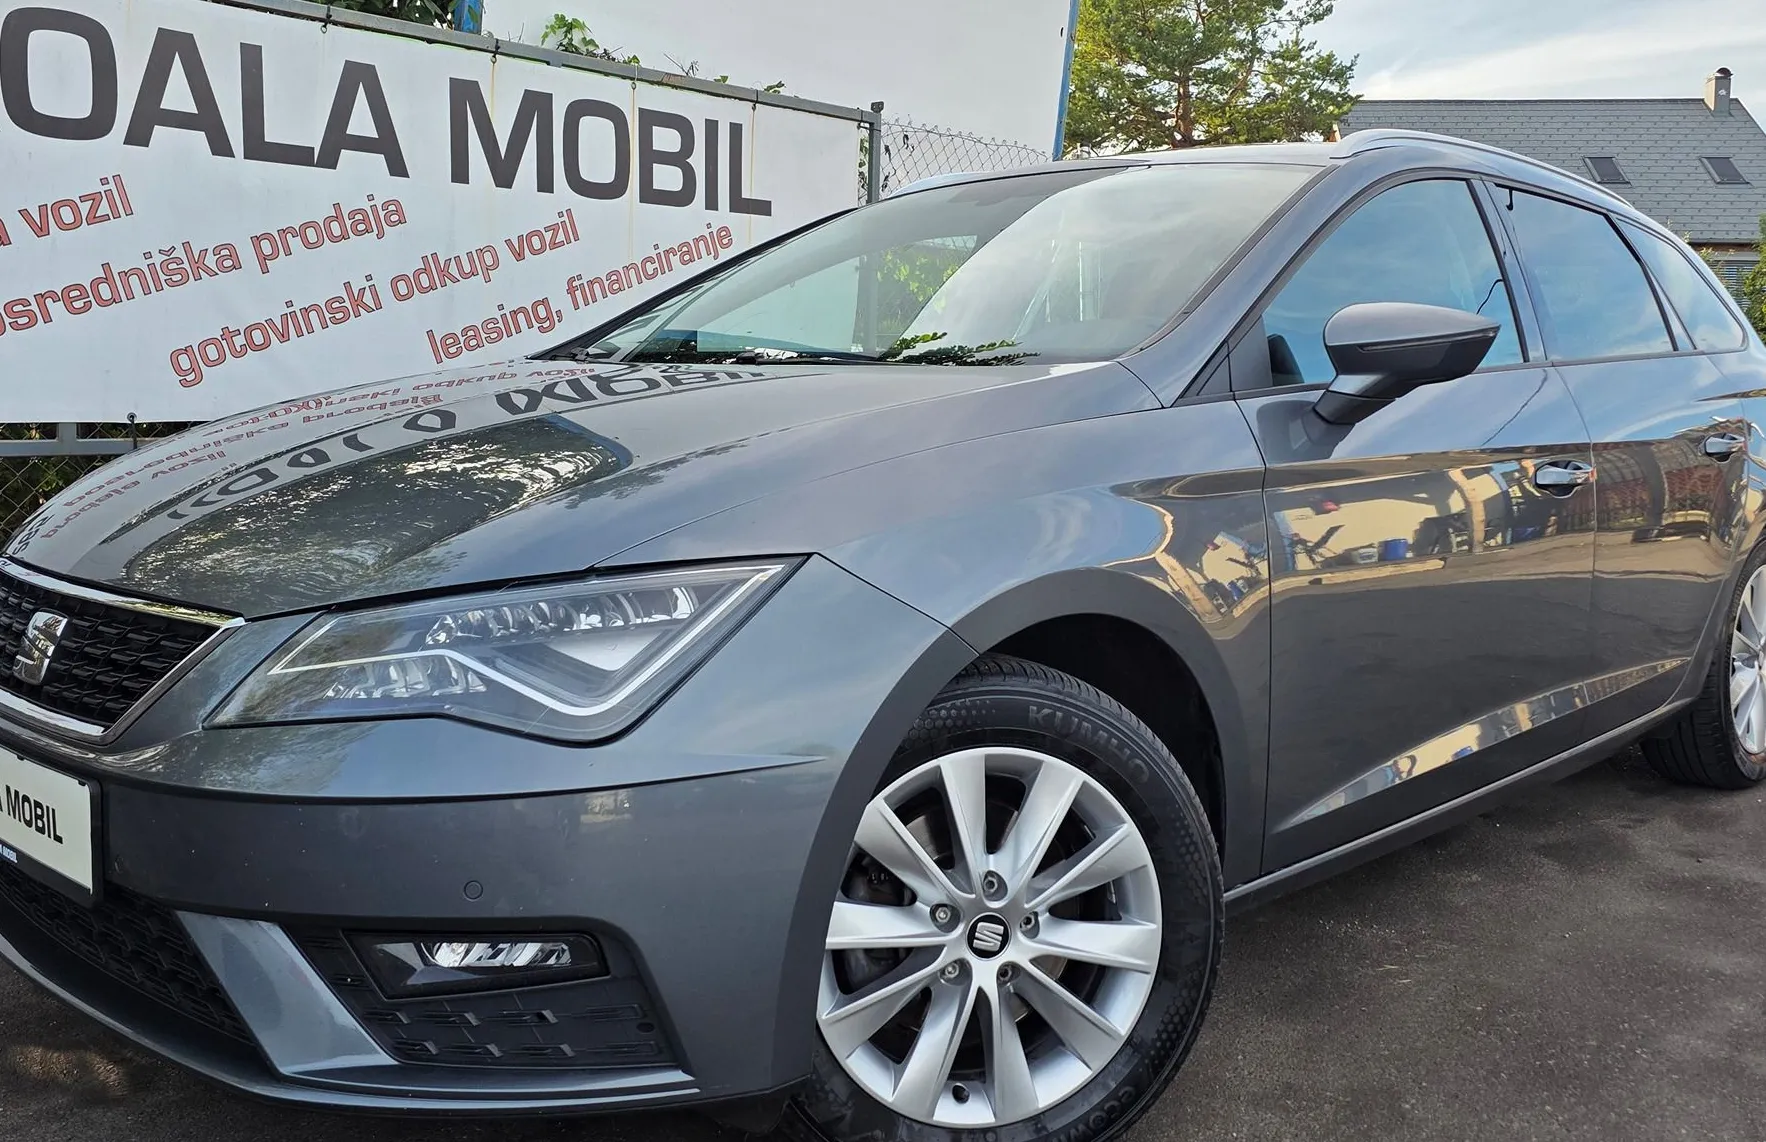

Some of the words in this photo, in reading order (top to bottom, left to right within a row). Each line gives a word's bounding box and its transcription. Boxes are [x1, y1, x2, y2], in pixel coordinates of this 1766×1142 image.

[2, 7, 410, 179] OALA
[449, 77, 772, 217] MOBIL
[0, 241, 242, 337] sredniška
[250, 194, 407, 275] prodaja
[18, 174, 134, 238] vozil
[169, 274, 383, 388] gotovinski
[390, 244, 500, 303] odkup
[505, 208, 580, 264] vozil
[427, 296, 563, 364] leasing,
[567, 223, 734, 311] financiranje
[5, 784, 63, 844] MOBIL
[1028, 705, 1149, 784] KUMHO
